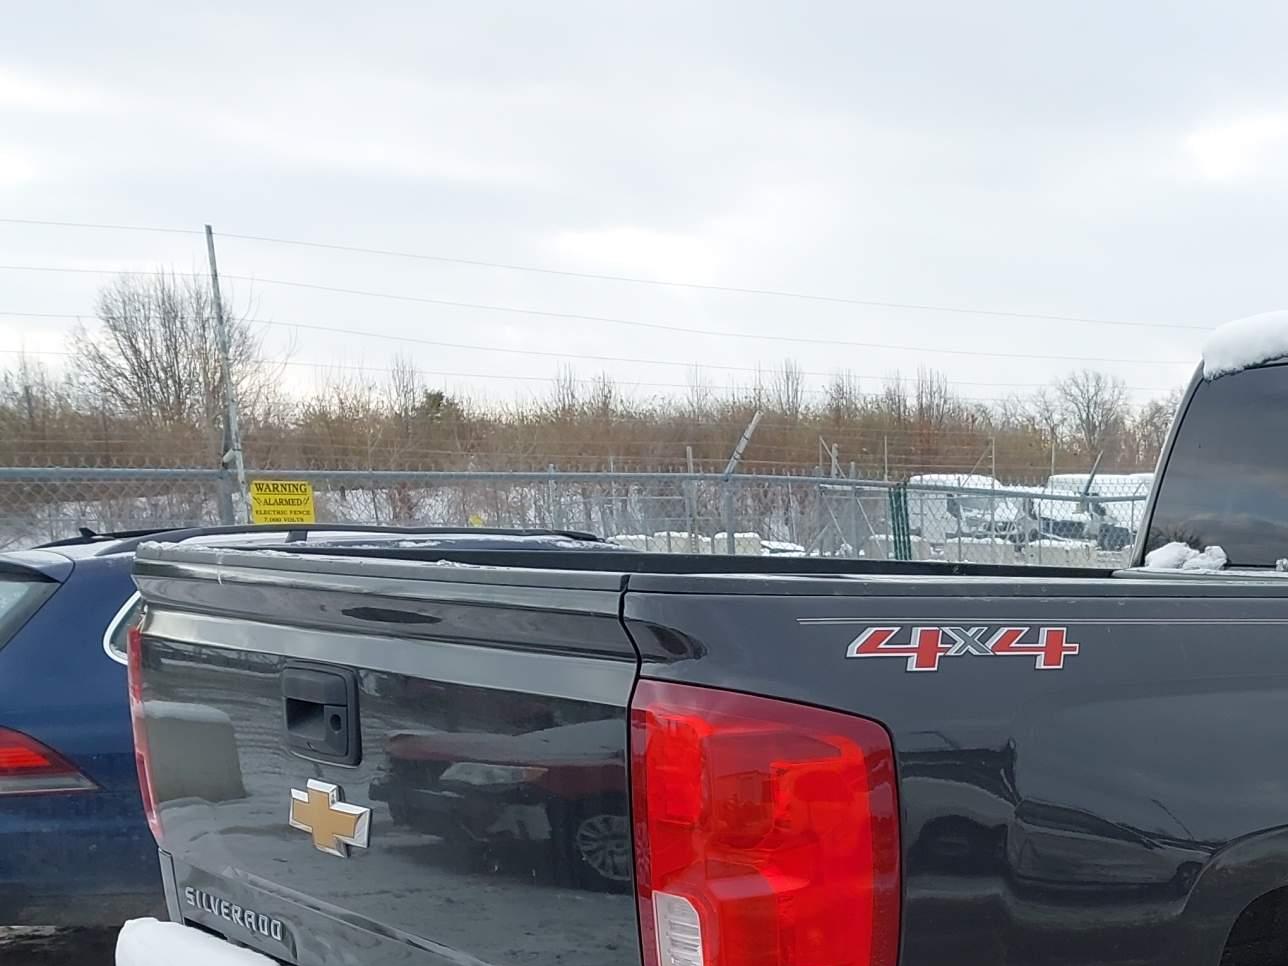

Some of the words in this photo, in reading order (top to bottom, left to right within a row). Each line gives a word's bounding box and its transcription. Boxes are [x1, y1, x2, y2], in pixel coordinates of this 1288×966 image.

[254, 483, 307, 493] WARNING
[263, 498, 303, 506] ALARMED
[184, 886, 282, 941] SILVERADO
